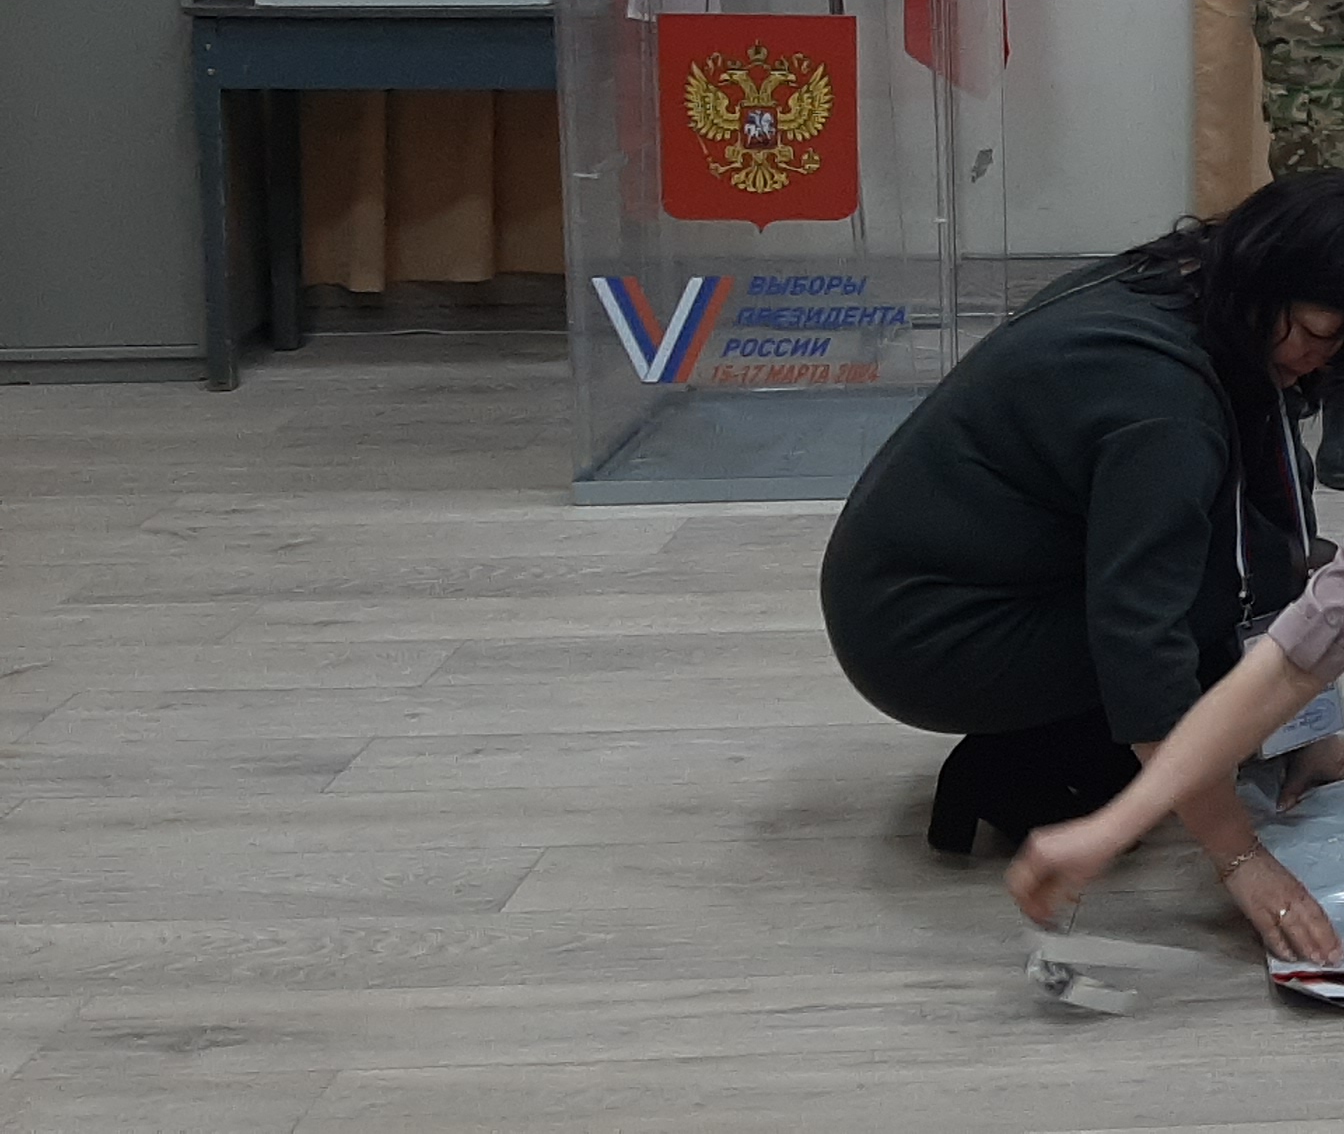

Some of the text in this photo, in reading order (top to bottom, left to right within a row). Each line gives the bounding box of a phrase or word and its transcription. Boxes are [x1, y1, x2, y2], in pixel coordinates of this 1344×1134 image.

[747, 275, 867, 296] ВЫБОРЫ
[735, 306, 907, 328] ПРЕЗИДЕНТА
[721, 337, 832, 358] РОССИИ
[766, 364, 830, 383] МАРТА
